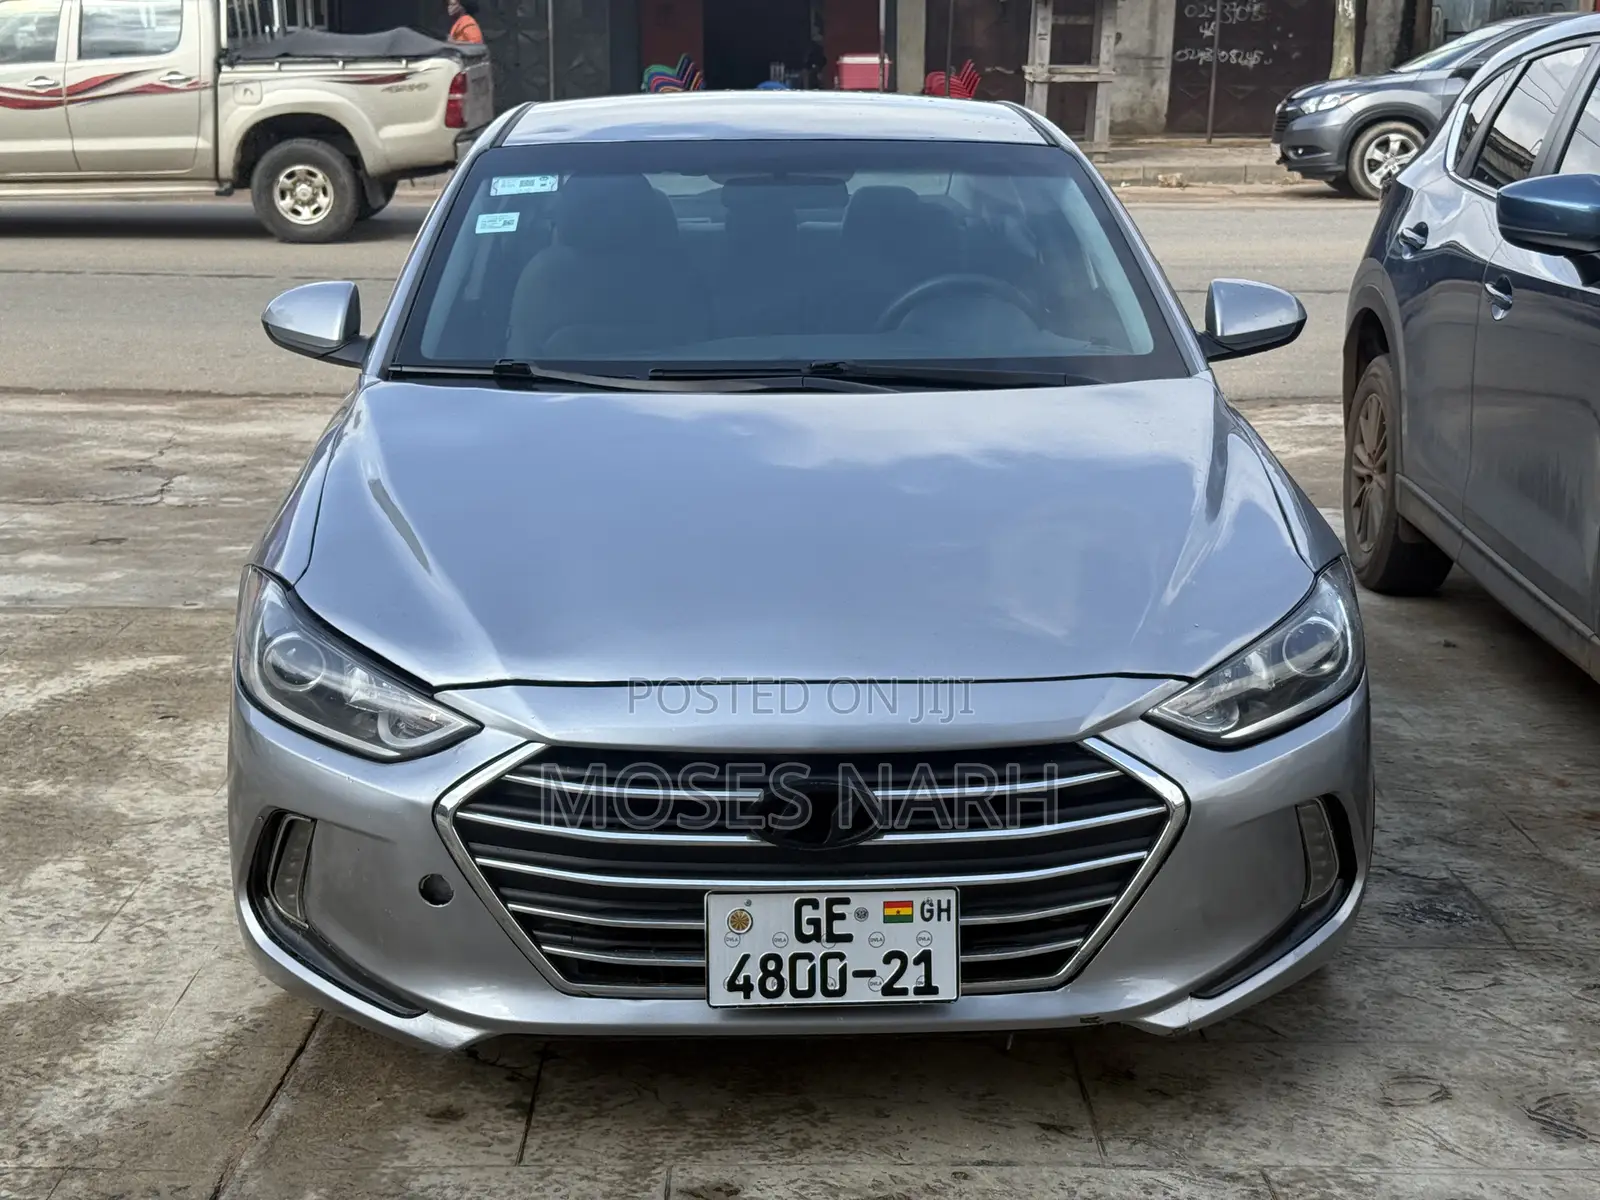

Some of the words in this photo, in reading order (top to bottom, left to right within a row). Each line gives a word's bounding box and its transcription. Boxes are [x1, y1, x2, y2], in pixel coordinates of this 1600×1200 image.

[794, 897, 854, 943] GE
[920, 899, 951, 922] GH
[727, 949, 939, 999] 4800-21
